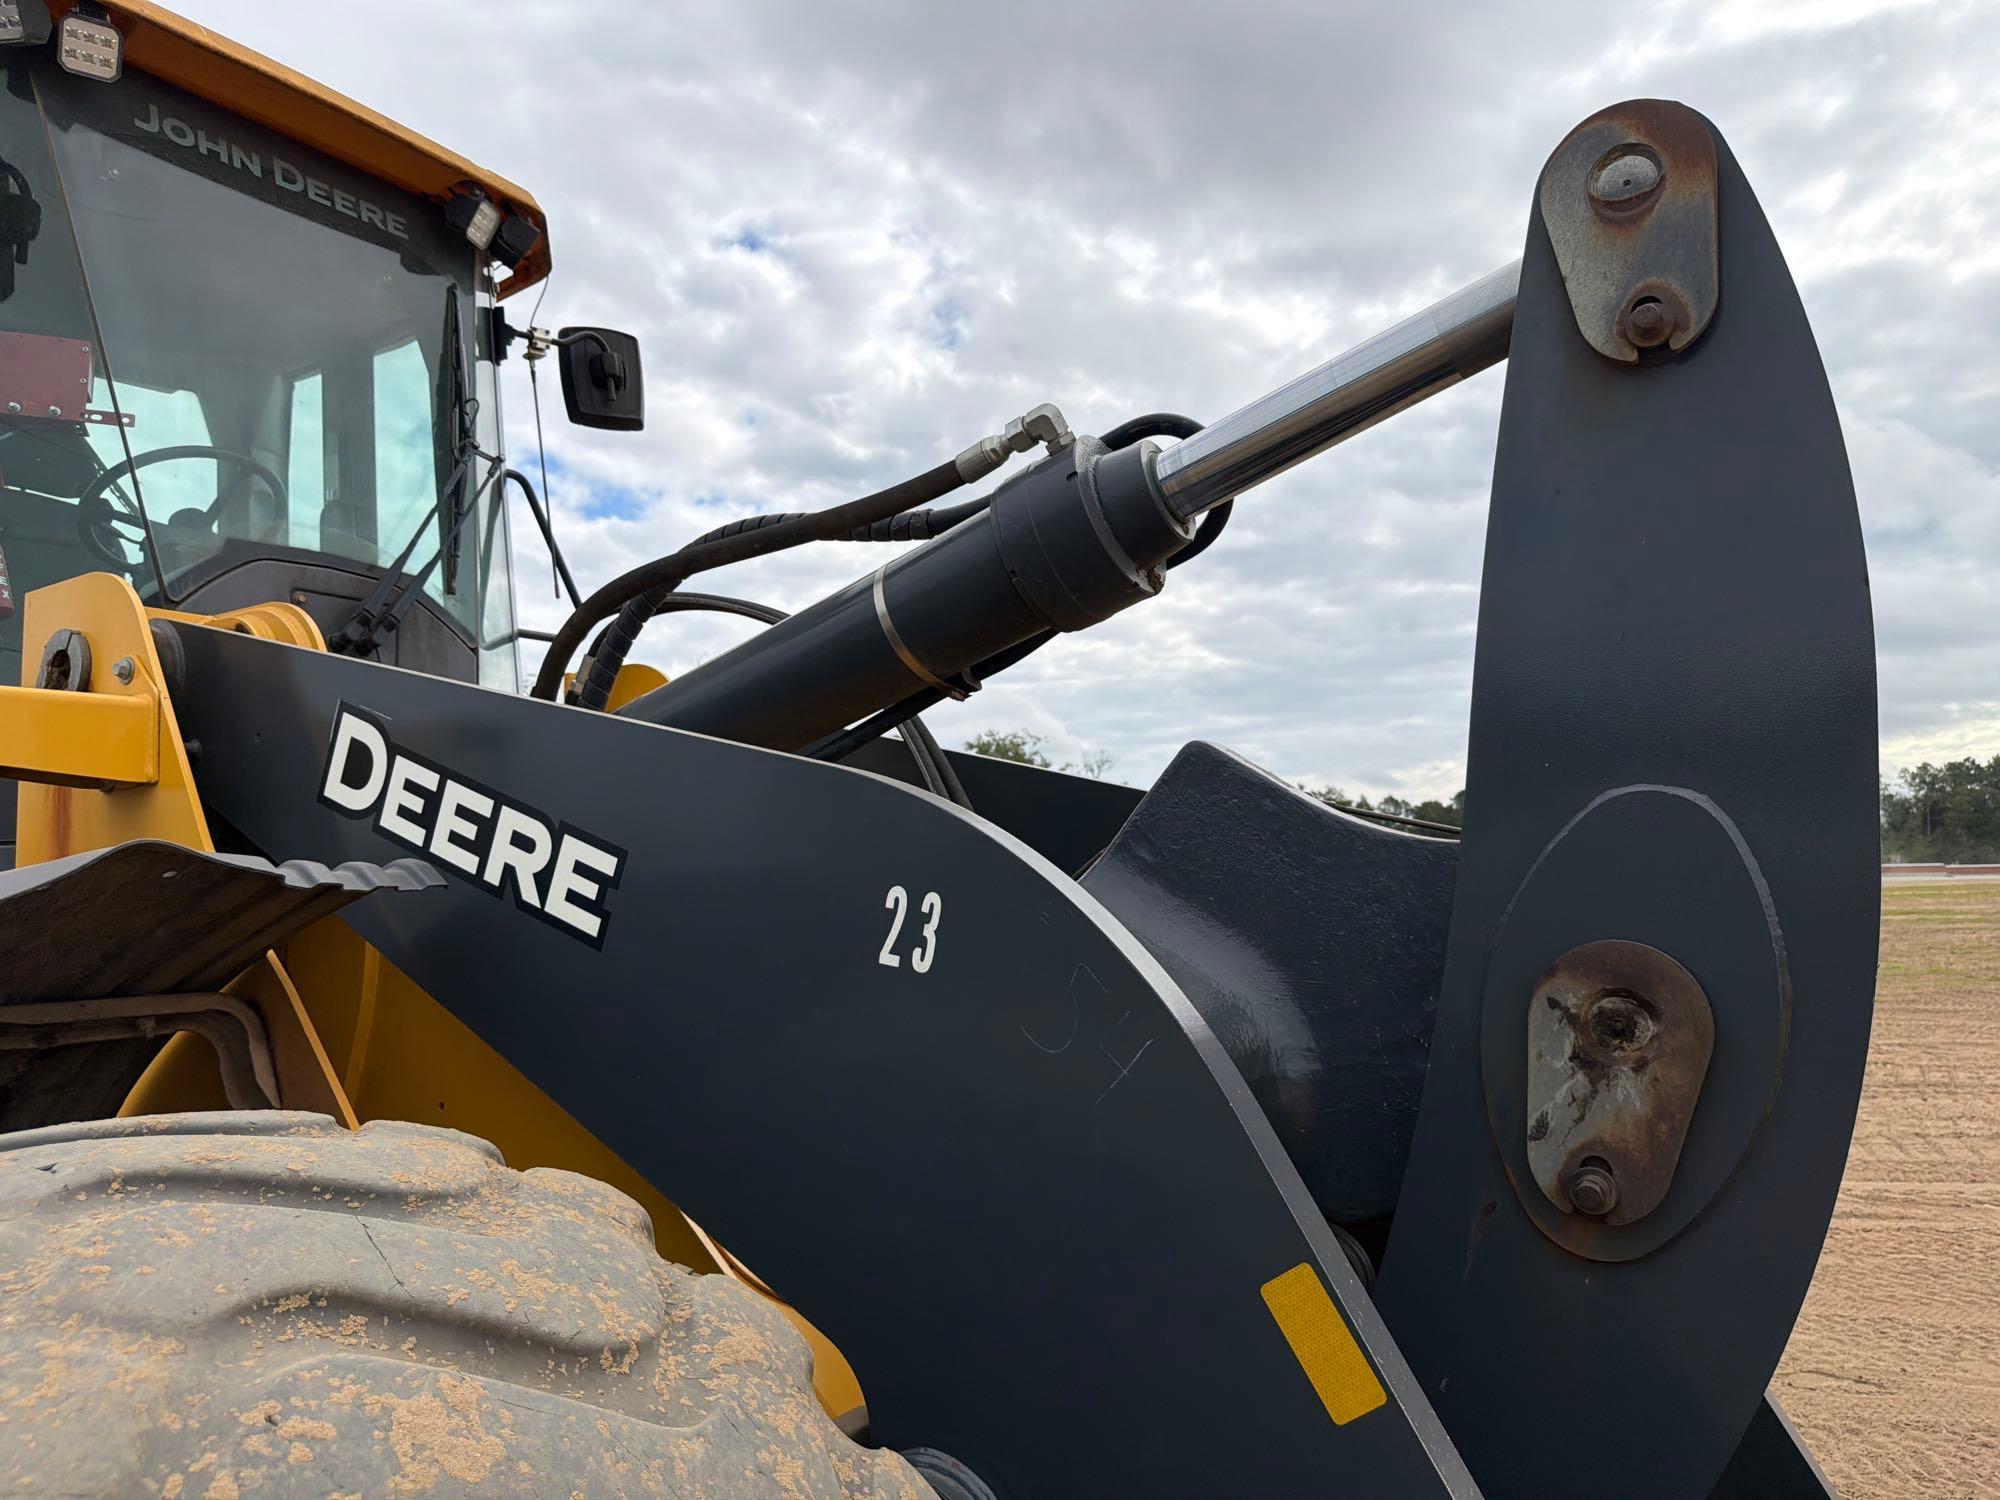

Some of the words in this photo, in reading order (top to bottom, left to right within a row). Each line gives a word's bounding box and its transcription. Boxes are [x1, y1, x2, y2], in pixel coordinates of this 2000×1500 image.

[134, 103, 263, 178] JOHN
[272, 157, 409, 241] DEERE
[323, 711, 619, 938] DEERE
[879, 885, 942, 973] 23
